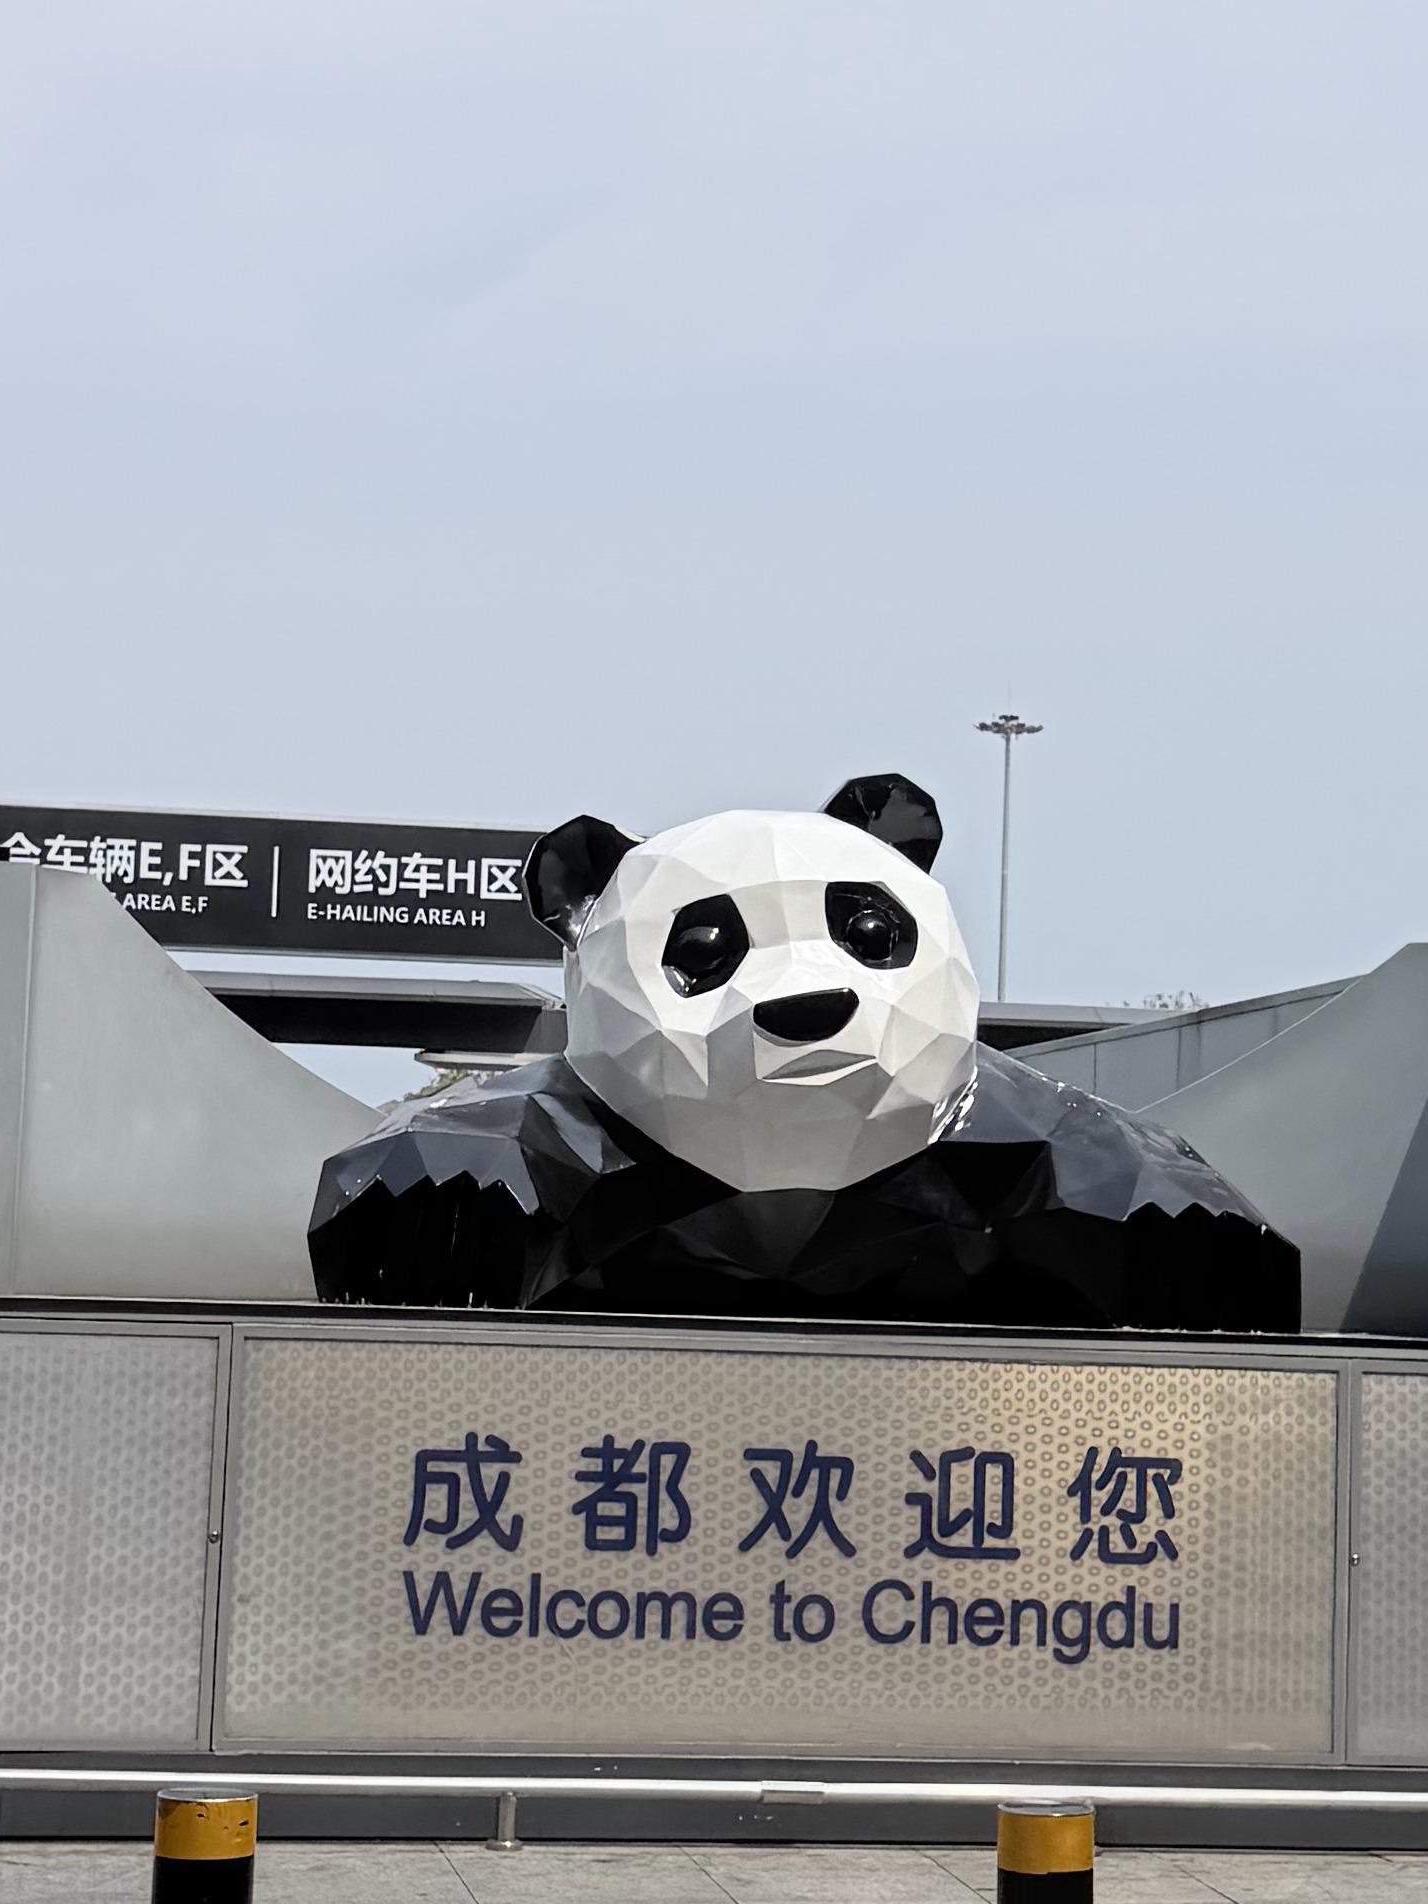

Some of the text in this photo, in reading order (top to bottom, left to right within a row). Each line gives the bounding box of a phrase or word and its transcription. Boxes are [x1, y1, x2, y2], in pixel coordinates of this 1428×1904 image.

[307, 848, 523, 901] 网约车H区
[123, 893, 209, 914] AREA E,F
[307, 902, 486, 928] E-HAILING AREA H
[402, 1431, 1184, 1566] 成都欢迎您
[402, 1570, 1183, 1666] Welcome to Chengdu
